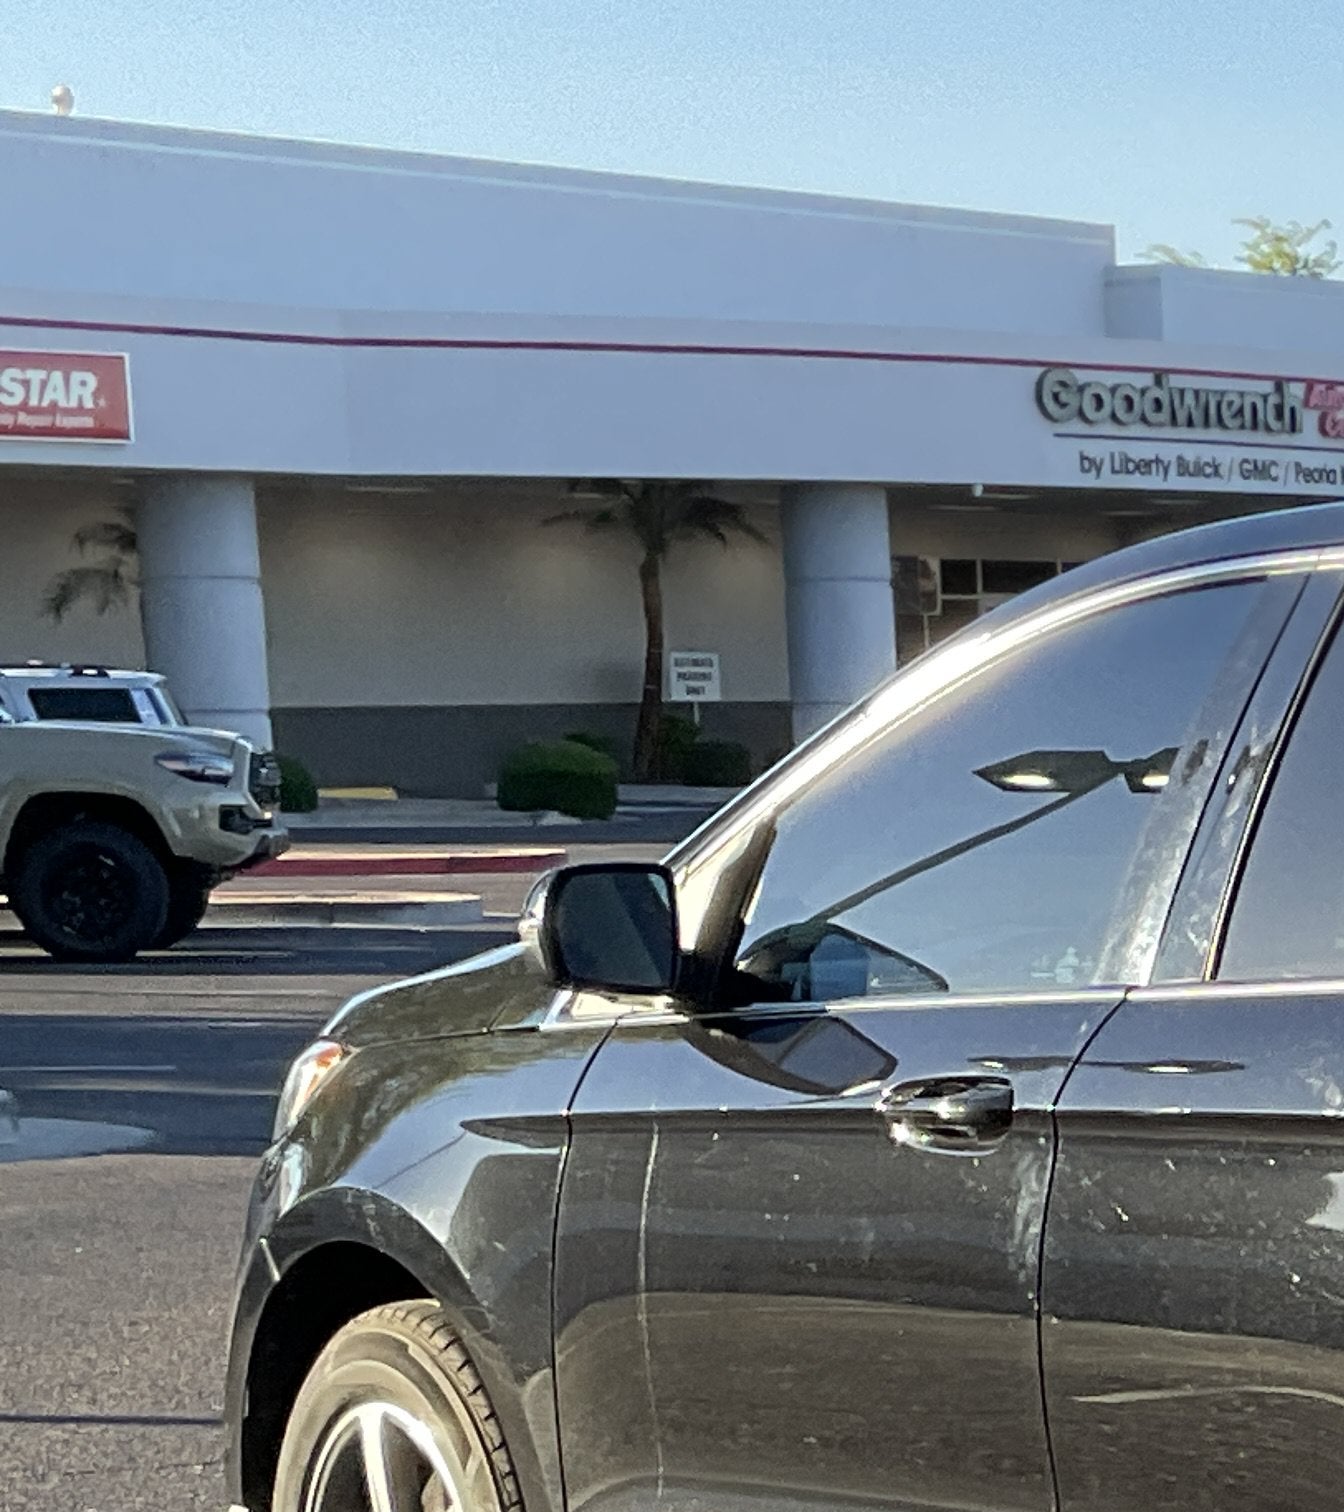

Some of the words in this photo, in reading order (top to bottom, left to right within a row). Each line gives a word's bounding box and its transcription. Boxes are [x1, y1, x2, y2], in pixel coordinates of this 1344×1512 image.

[1036, 367, 1302, 434] Goodwrench
[1079, 451, 1104, 479] by
[1110, 452, 1171, 481] Liberty
[1176, 455, 1223, 478] Buick
[1239, 458, 1279, 482] GMC
